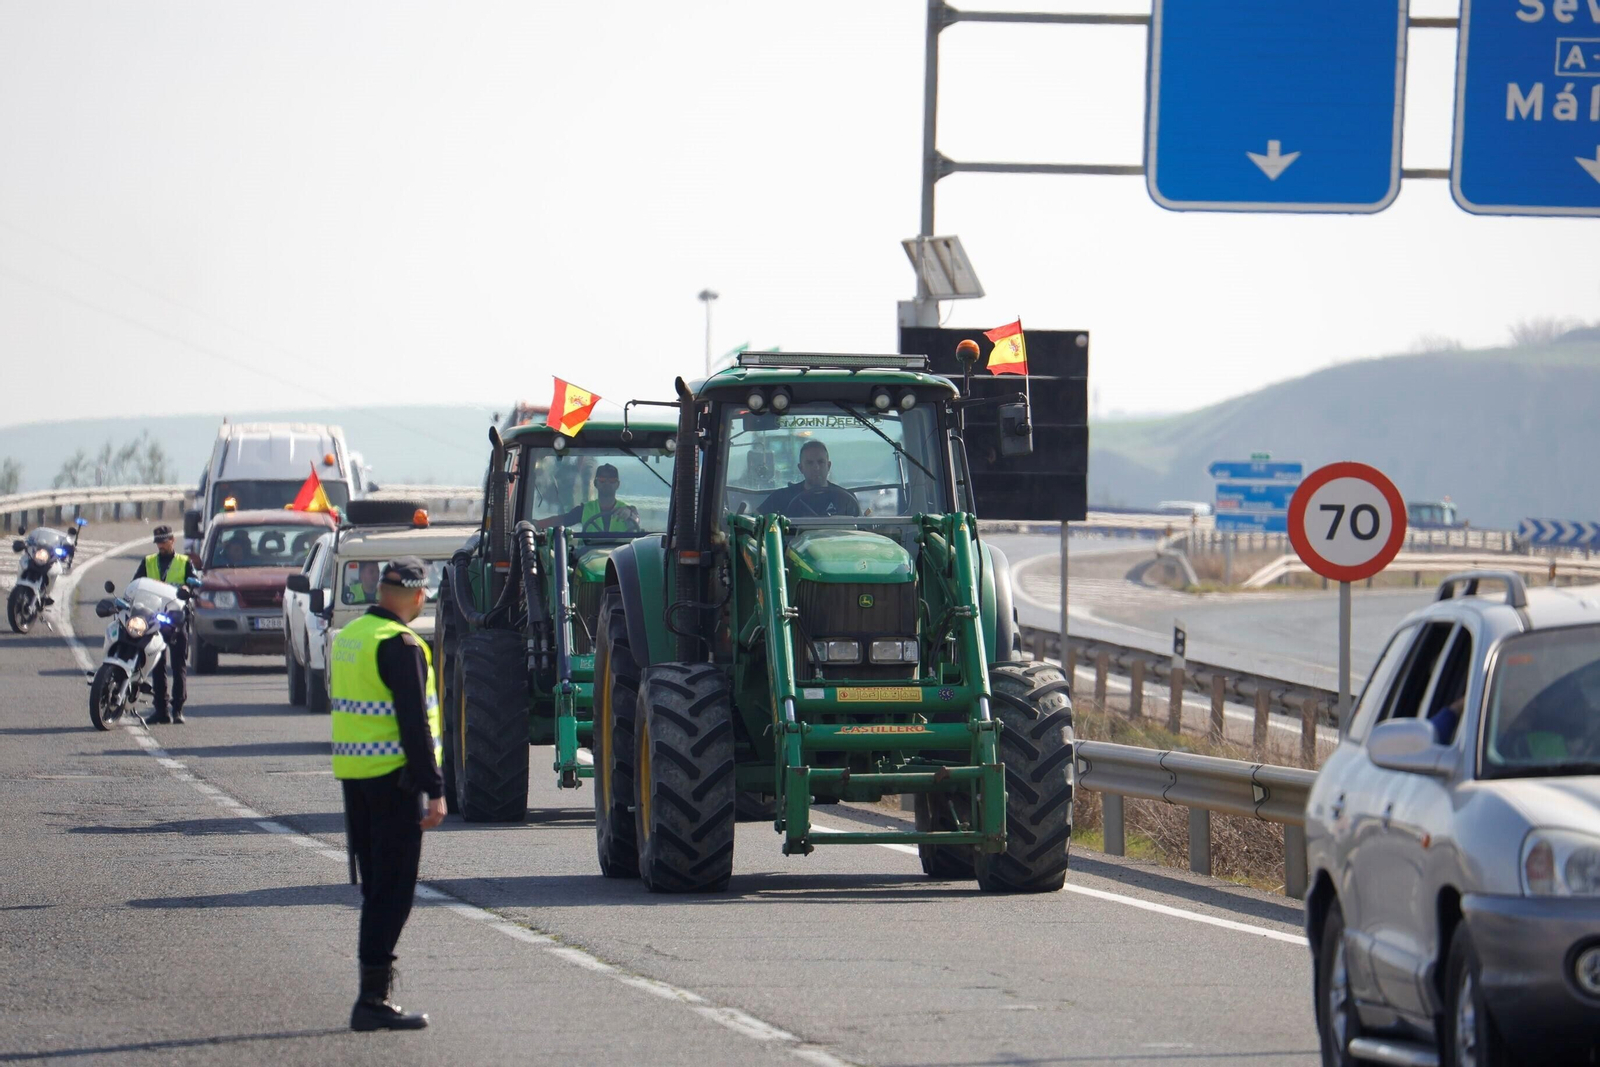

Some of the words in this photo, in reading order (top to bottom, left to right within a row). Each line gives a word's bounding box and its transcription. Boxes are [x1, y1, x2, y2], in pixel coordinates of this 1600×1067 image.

[826, 414, 869, 427] DEER
[1319, 503, 1380, 541] 70
[840, 725, 926, 733] CASTILLERO
